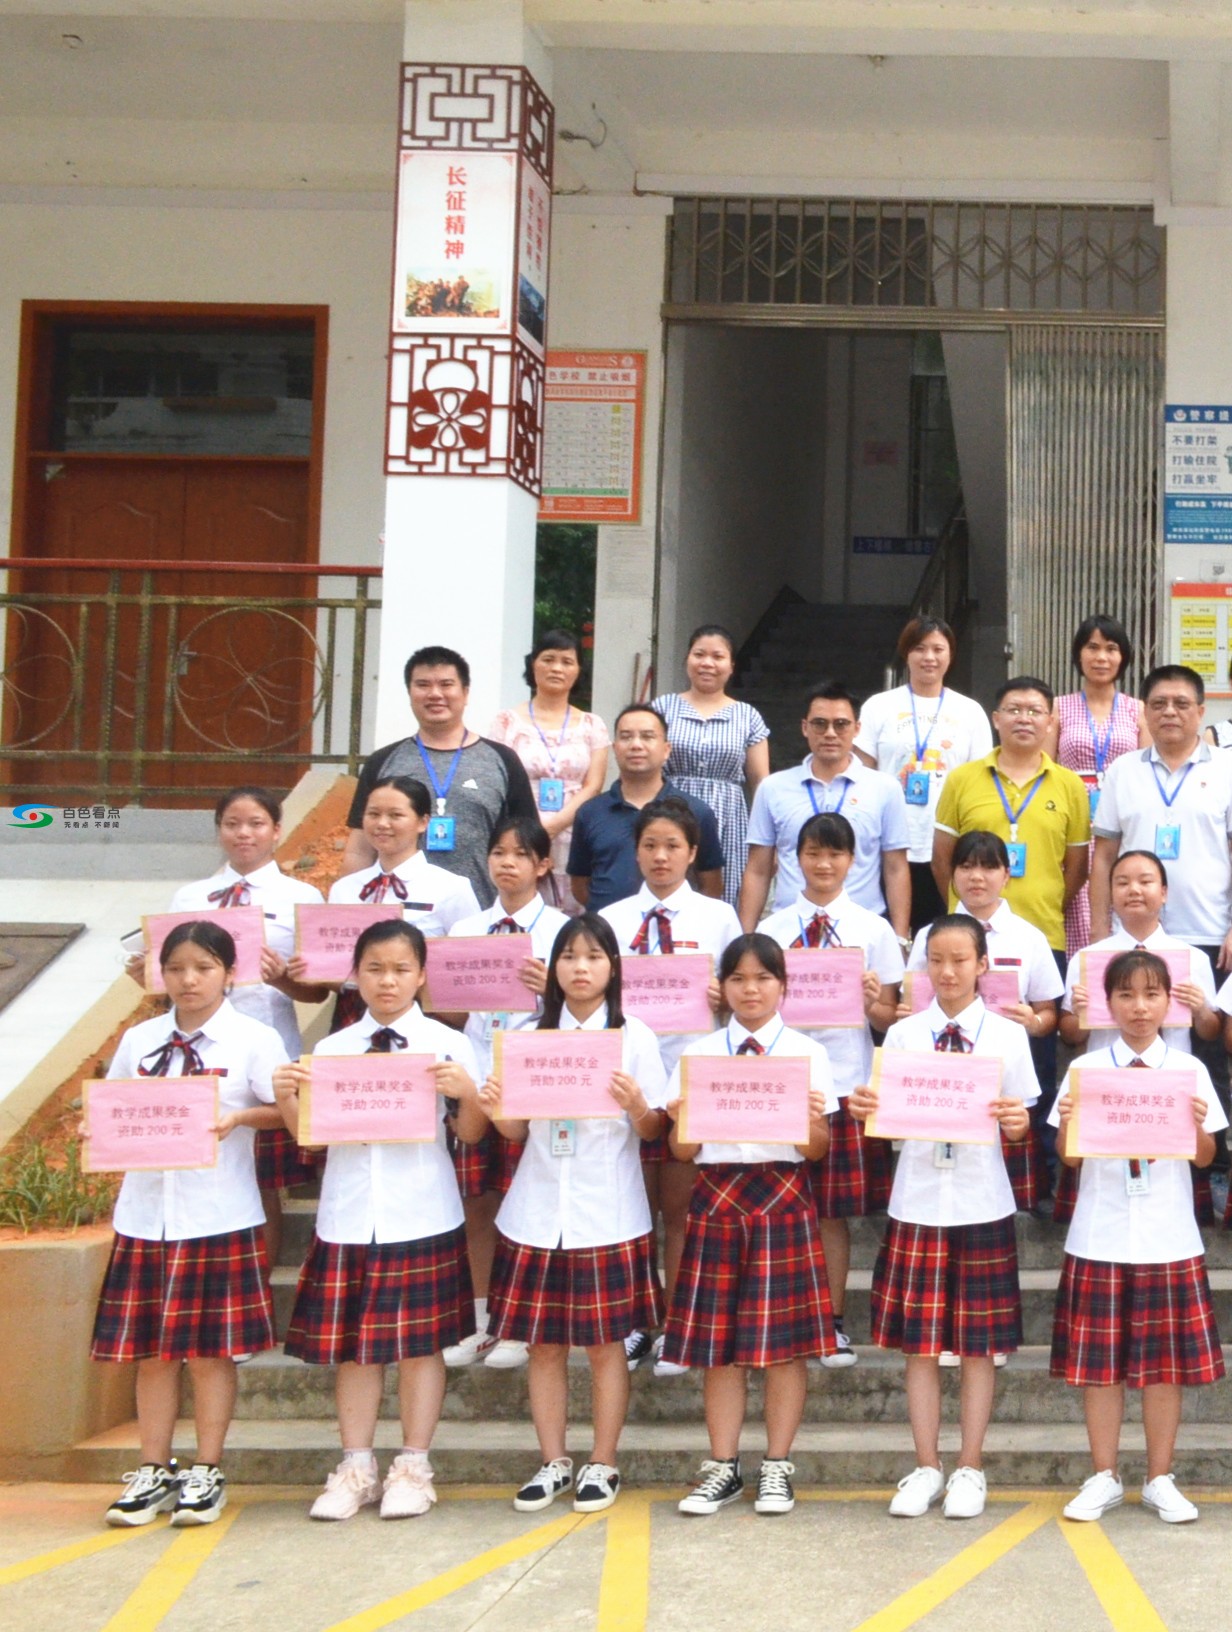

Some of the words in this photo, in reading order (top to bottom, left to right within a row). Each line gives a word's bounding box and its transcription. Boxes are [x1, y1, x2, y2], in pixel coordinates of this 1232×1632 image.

[444, 166, 466, 260] 长征精神
[588, 371, 631, 381] 禁止吸烟
[1172, 436, 1217, 446] 不要打架
[1172, 454, 1217, 466] 打输住院
[1172, 474, 1217, 484] 打赢坐牢
[446, 958, 514, 972] 教学成果奖金
[478, 975, 496, 986] 200
[652, 995, 670, 1005] 200
[806, 989, 825, 999] 200
[524, 1056, 598, 1070] 教学成果奖金
[558, 1075, 577, 1086] 200
[902, 1076, 976, 1093] 教学成果奖金
[334, 1080, 412, 1094] 教学成果奖金
[710, 1081, 786, 1094] 教学成果奖金
[370, 1100, 390, 1110] 200
[744, 1100, 764, 1110] 200
[934, 1096, 954, 1108] 200
[1102, 1094, 1175, 1108] 教学成果奖金
[112, 1104, 190, 1118] 教学成果奖金
[1134, 1113, 1154, 1124] 200
[148, 1124, 168, 1136] 200
